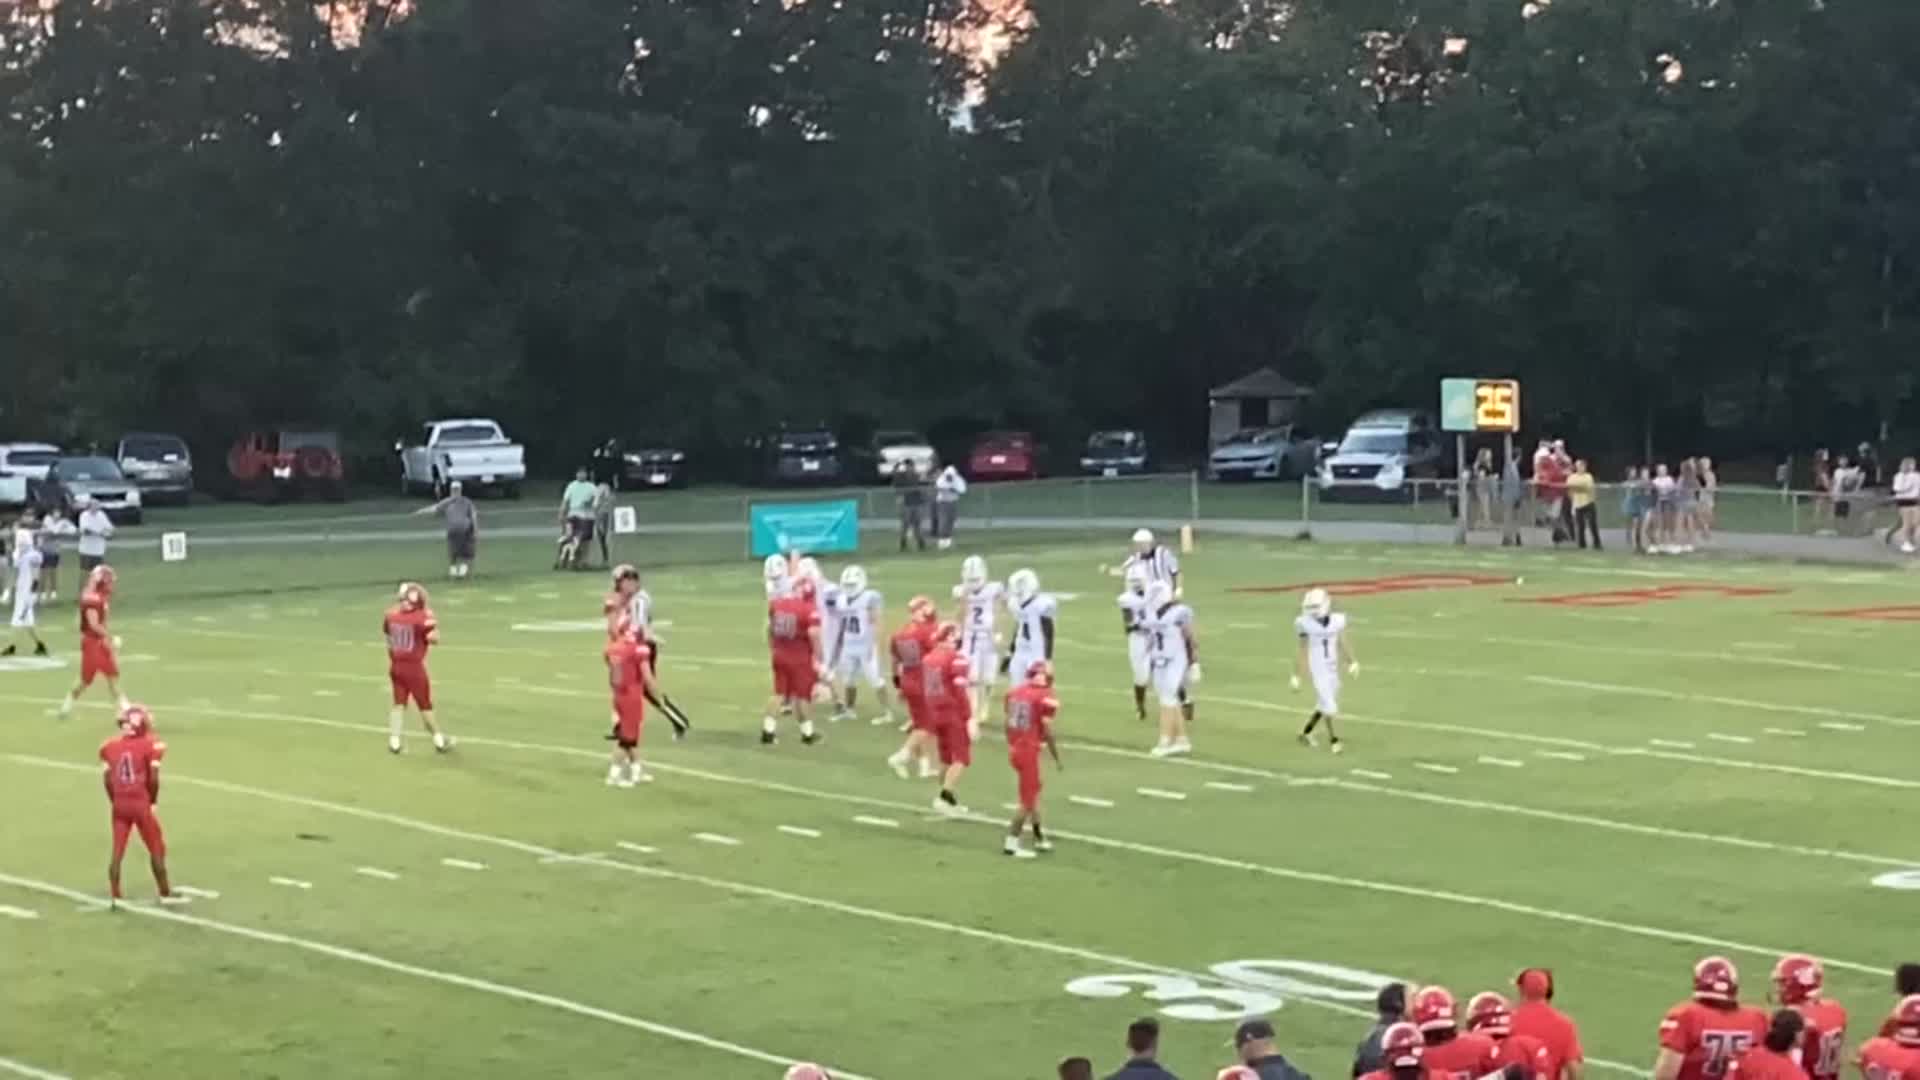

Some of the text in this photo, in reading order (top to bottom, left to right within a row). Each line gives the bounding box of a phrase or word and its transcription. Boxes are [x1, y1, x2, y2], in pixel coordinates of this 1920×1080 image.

[1476, 385, 1512, 425] 25
[972, 606, 984, 625] 2
[1321, 637, 1330, 659] 1
[117, 751, 136, 785] 4
[1063, 958, 1402, 1021] 30
